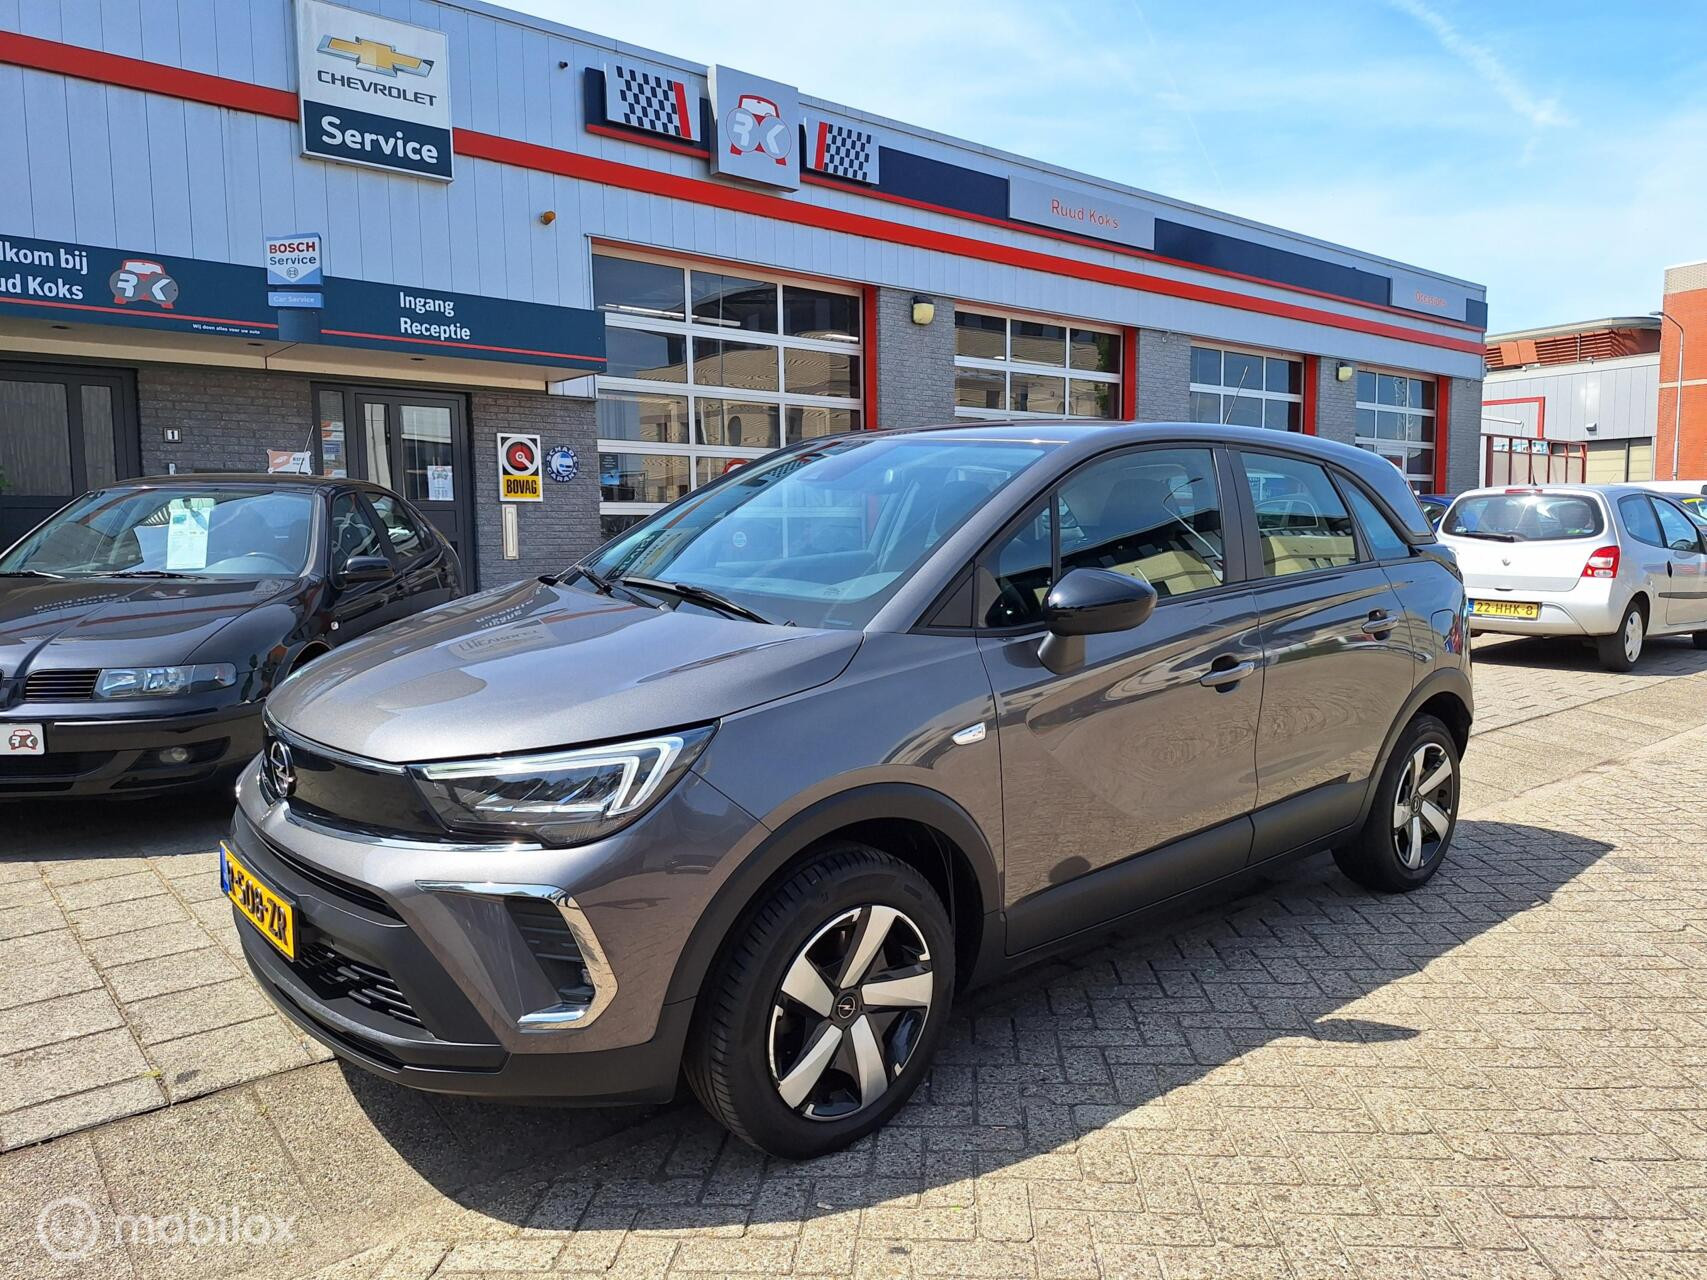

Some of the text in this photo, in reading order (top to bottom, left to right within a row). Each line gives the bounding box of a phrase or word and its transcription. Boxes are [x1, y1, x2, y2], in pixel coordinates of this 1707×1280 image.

[317, 70, 437, 106] CHEVROLET
[321, 115, 438, 163] Service
[1051, 199, 1120, 229] Ruud Koks
[269, 241, 316, 254] BOSCH
[59, 248, 88, 275] bij
[269, 254, 317, 266] Service
[27, 275, 84, 300] Koks
[287, 295, 315, 303] Service
[399, 291, 455, 317] Ingang
[400, 317, 471, 341] Receptie
[506, 479, 537, 495] BOVAG
[1476, 602, 1533, 616] 22-HHK-8
